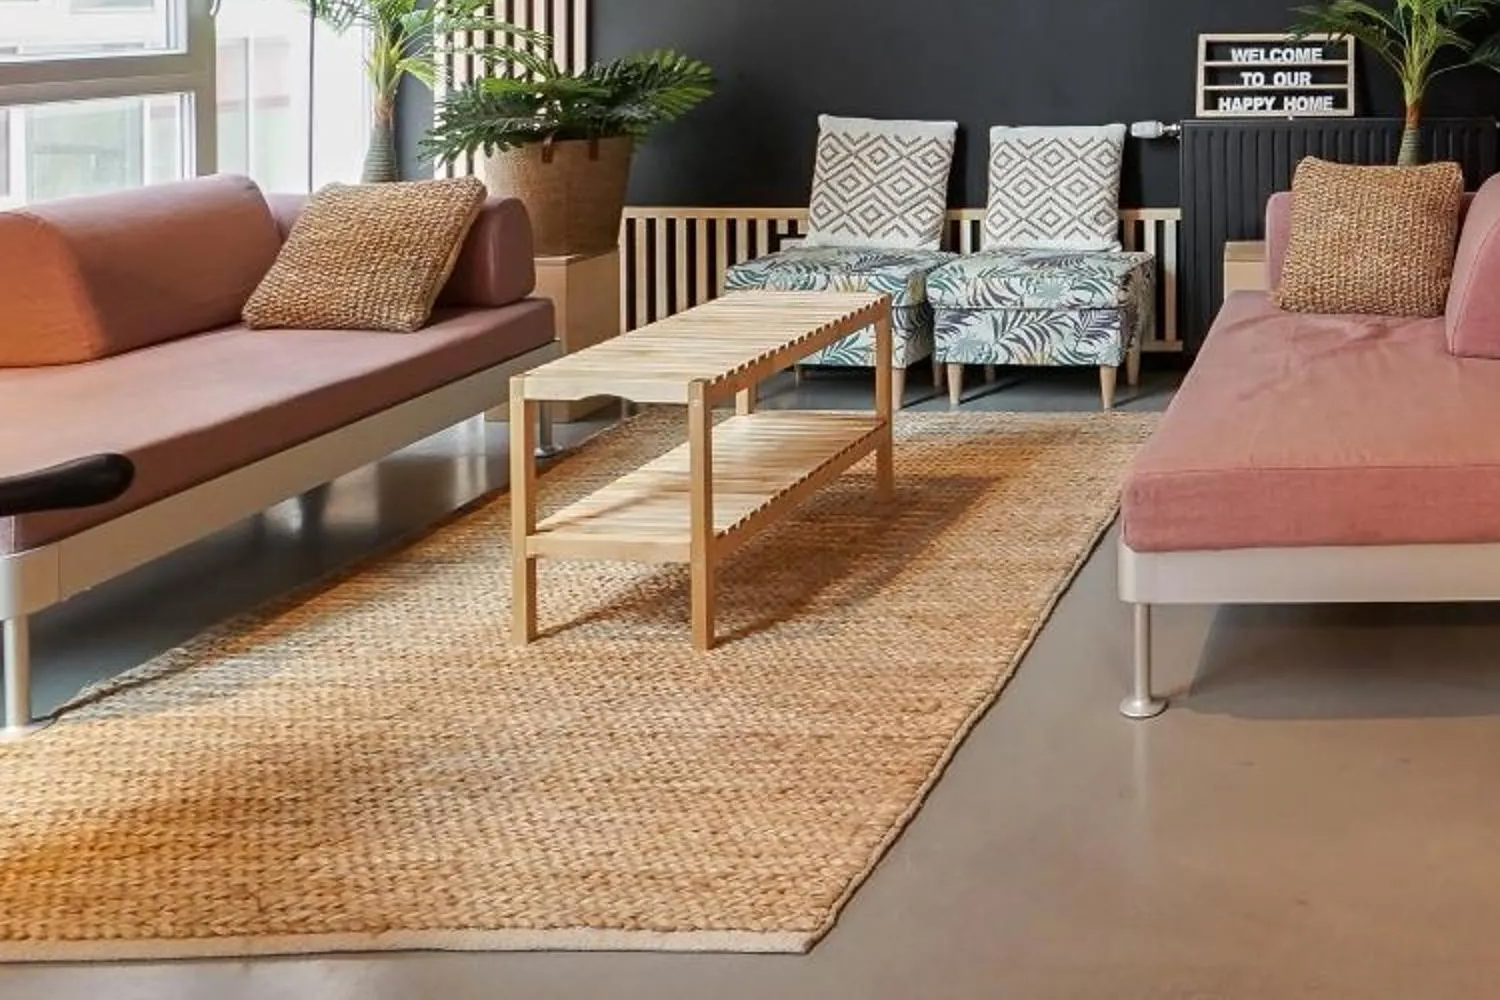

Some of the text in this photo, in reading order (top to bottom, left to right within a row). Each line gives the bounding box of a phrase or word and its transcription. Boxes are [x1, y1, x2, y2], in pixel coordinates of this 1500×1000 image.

[1230, 47, 1323, 62] WELCOME
[1240, 71, 1312, 86] TO OUR
[1218, 95, 1334, 112] HAPPY HOME
